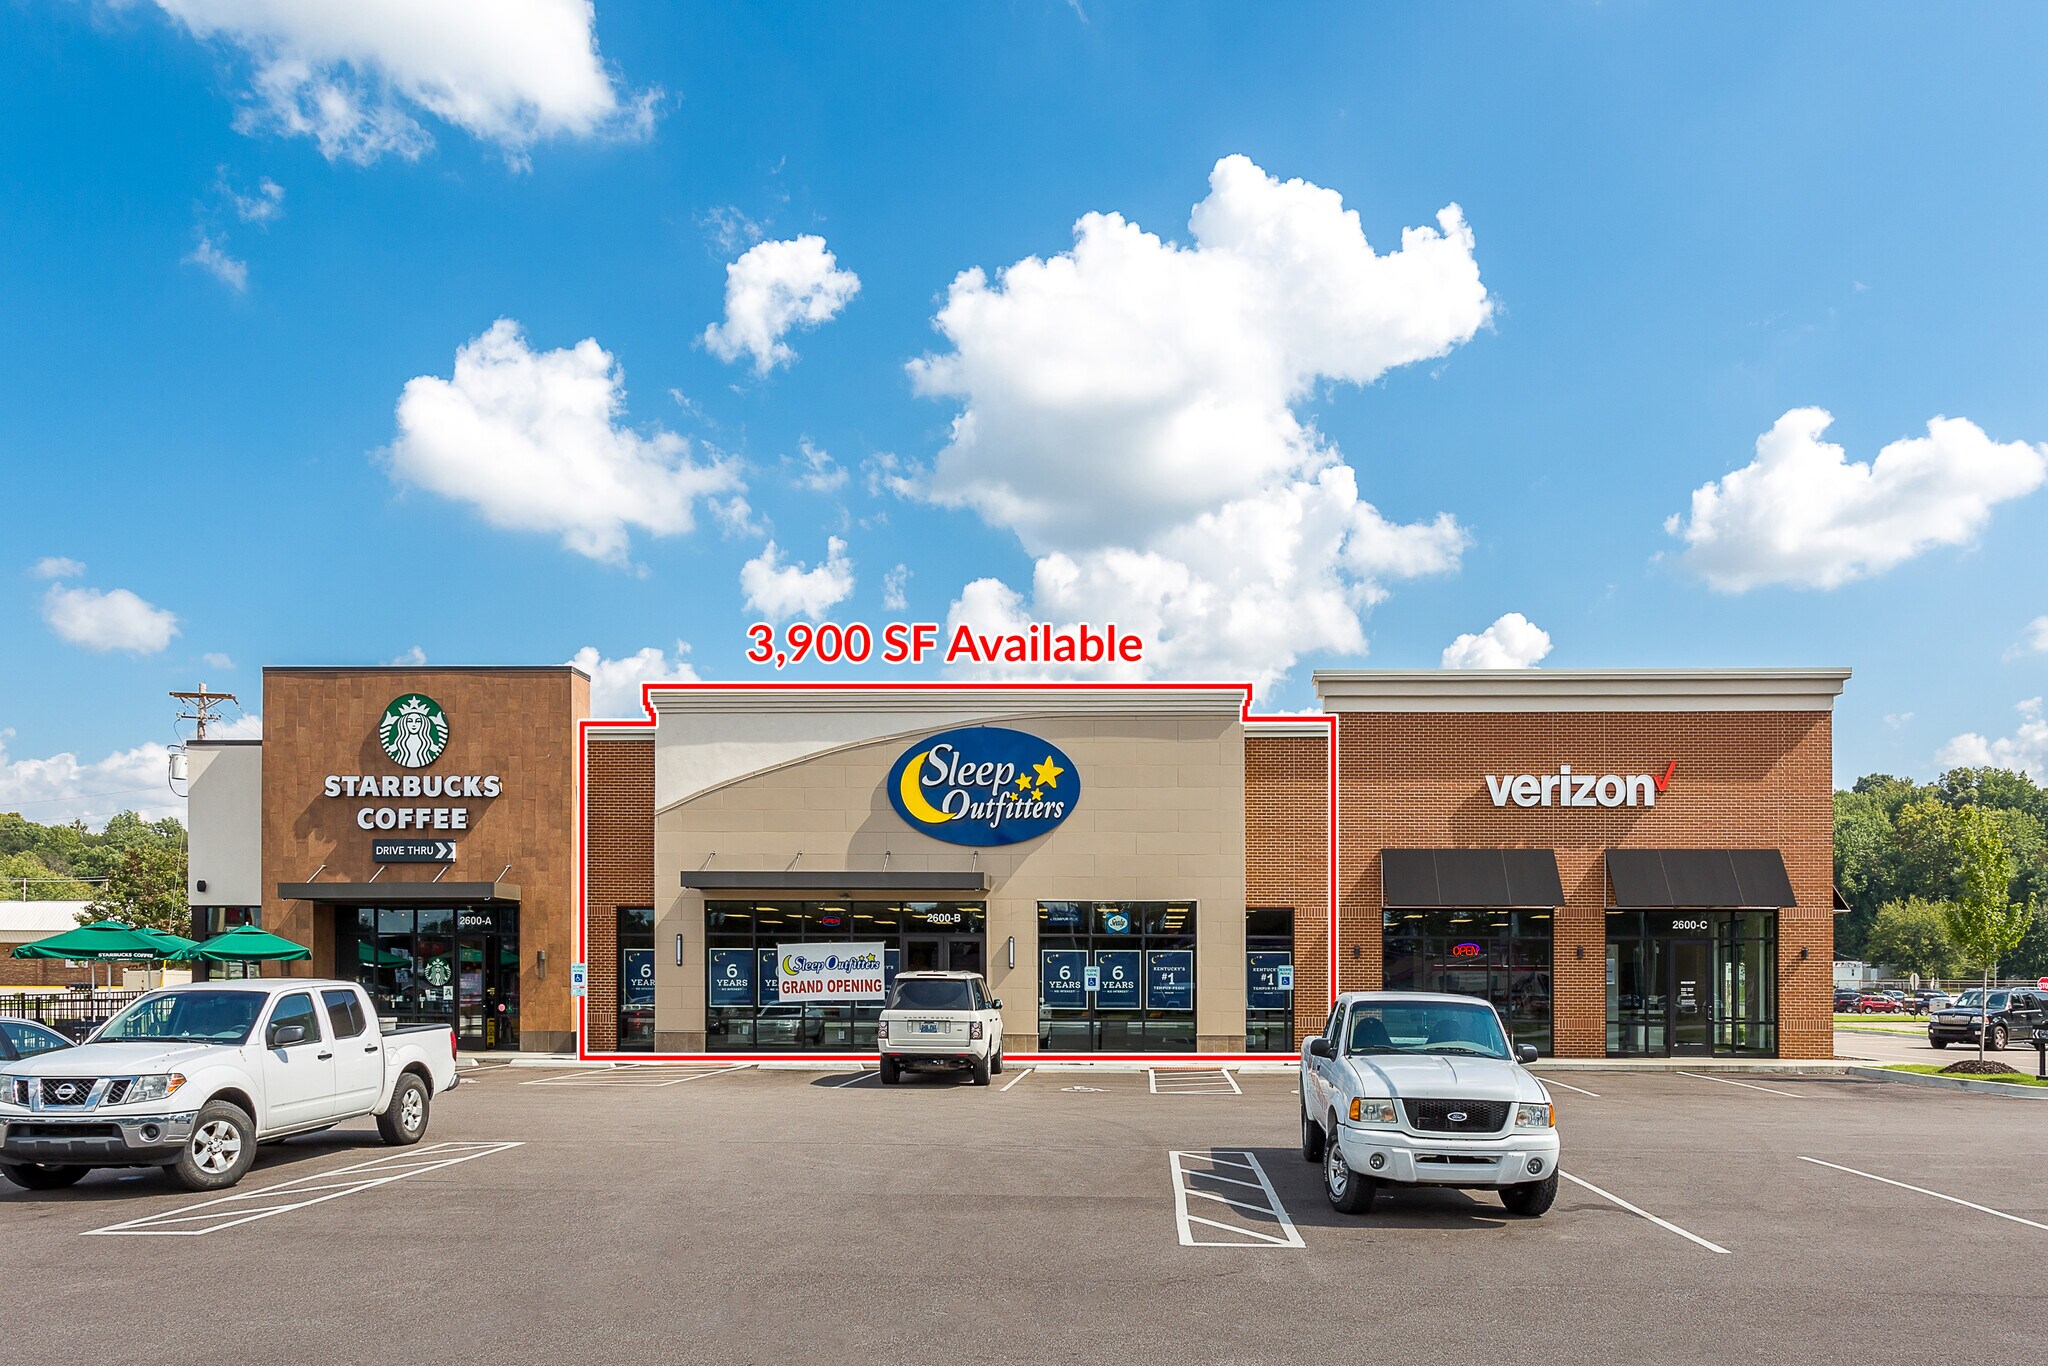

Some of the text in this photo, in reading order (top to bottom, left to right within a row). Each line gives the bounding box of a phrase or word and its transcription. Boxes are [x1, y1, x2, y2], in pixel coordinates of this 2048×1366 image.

[921, 743, 1015, 796] Sleep
[324, 775, 501, 797] STARBUCKS
[1485, 764, 1656, 807] verizon
[942, 789, 1064, 828] Outfitters
[357, 807, 467, 830] COFFEE
[375, 846, 434, 855] DRIVE THRU
[460, 916, 492, 925] 2600-A
[822, 917, 841, 925] OPEN
[926, 913, 961, 923] 2600-B
[1672, 920, 1708, 930] 2600-C
[1452, 945, 1479, 957] OPEN
[640, 963, 651, 978] 6
[726, 963, 738, 978] 6
[793, 954, 881, 974] Sleep Outfitters
[1059, 965, 1071, 980] 6
[1112, 965, 1124, 980] 6
[1161, 972, 1175, 985] #1
[631, 979, 656, 987] YEAR
[716, 979, 748, 987] YEARS
[1049, 981, 1081, 989] YEARS
[1101, 981, 1134, 989] YEARS
[1260, 973, 1274, 986] #1
[781, 980, 824, 994] GRAND
[826, 979, 882, 994] OPENING
